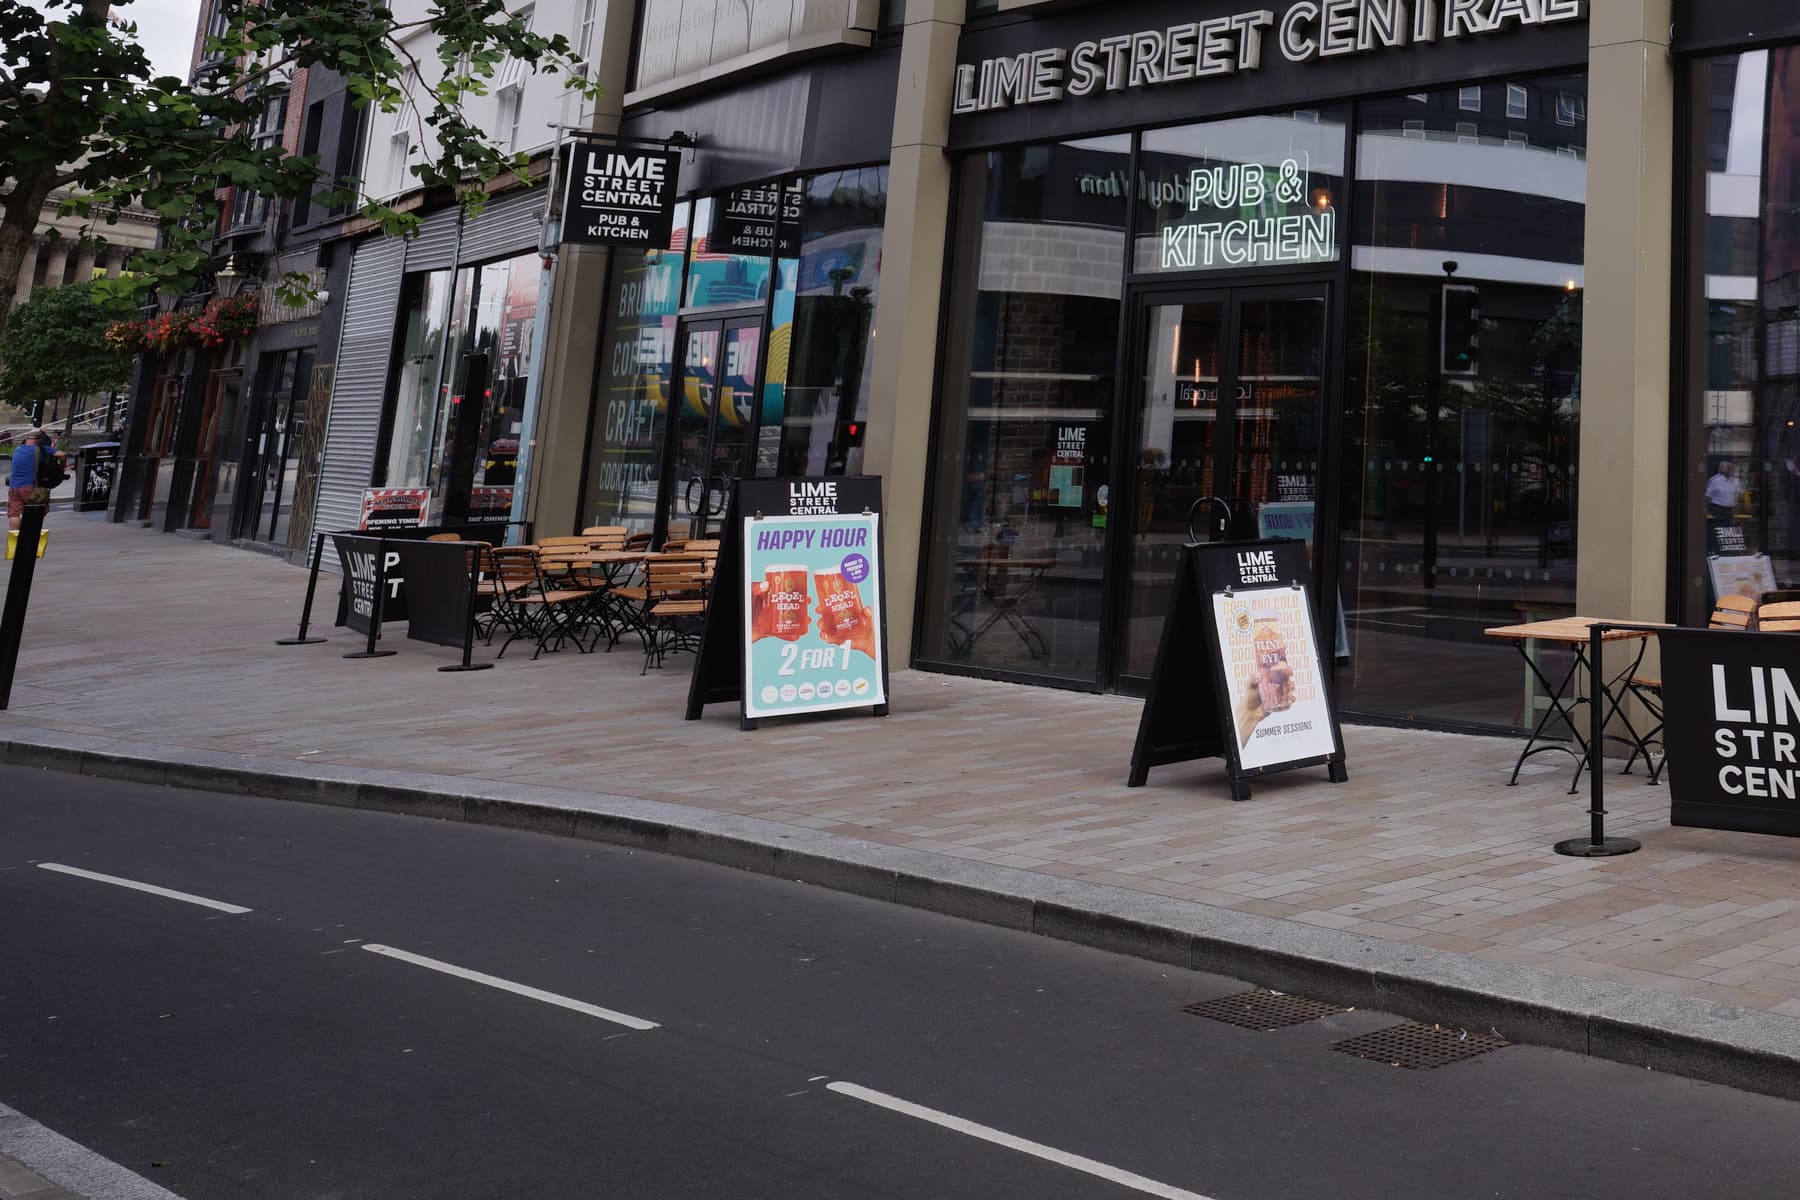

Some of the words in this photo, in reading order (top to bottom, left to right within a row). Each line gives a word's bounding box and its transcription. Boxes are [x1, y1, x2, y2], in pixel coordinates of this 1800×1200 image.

[953, 46, 1067, 115] LIME
[1066, 9, 1274, 97] STREET
[586, 151, 667, 181] LIME
[583, 176, 664, 193] STREET
[1190, 161, 1266, 212] PUB
[1277, 156, 1305, 202] &
[581, 190, 662, 208] CENTRAL
[598, 213, 628, 226] PUB
[631, 215, 641, 227] &
[587, 225, 650, 240] KITCHEN
[1160, 212, 1336, 269] KITCHEN
[604, 399, 659, 442] CRAFT
[1057, 427, 1086, 442] LIME
[1056, 449, 1085, 458] CENTRAL
[1057, 441, 1085, 450] STREET
[599, 462, 652, 492] COCKTAILS
[790, 482, 837, 497] LIME
[790, 497, 838, 506] STREET
[790, 506, 838, 515] CENTRAL
[757, 529, 817, 551] HAPPY
[820, 527, 867, 549] HOUR
[346, 551, 377, 580] LIME
[1237, 551, 1276, 567] LIME
[1239, 565, 1277, 575] STREET
[1241, 574, 1279, 584] CENTRAL
[353, 581, 374, 599] STREE
[354, 598, 374, 617] CENTR
[1274, 594, 1299, 609] COLD
[778, 644, 799, 676] 2
[800, 648, 836, 670] FOR
[839, 640, 853, 671] 1
[1262, 654, 1280, 664] EYE
[1255, 725, 1282, 739] SUMMER
[1283, 720, 1313, 735] SESSIONS
